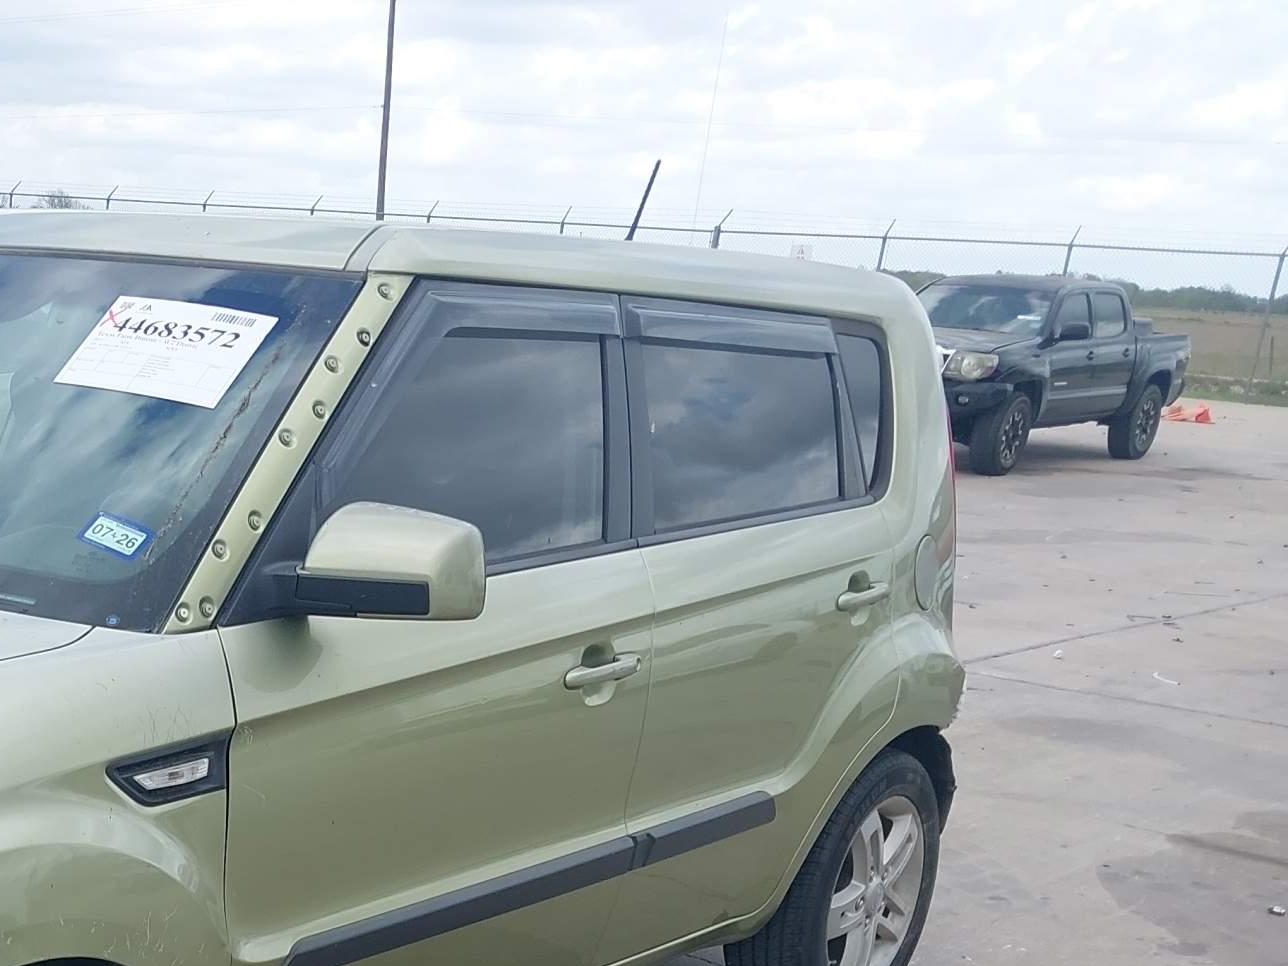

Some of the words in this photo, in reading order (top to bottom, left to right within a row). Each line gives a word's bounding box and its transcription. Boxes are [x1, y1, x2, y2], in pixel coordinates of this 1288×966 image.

[113, 316, 241, 349] 44683572
[91, 523, 113, 538] 07
[115, 533, 139, 549] 26
